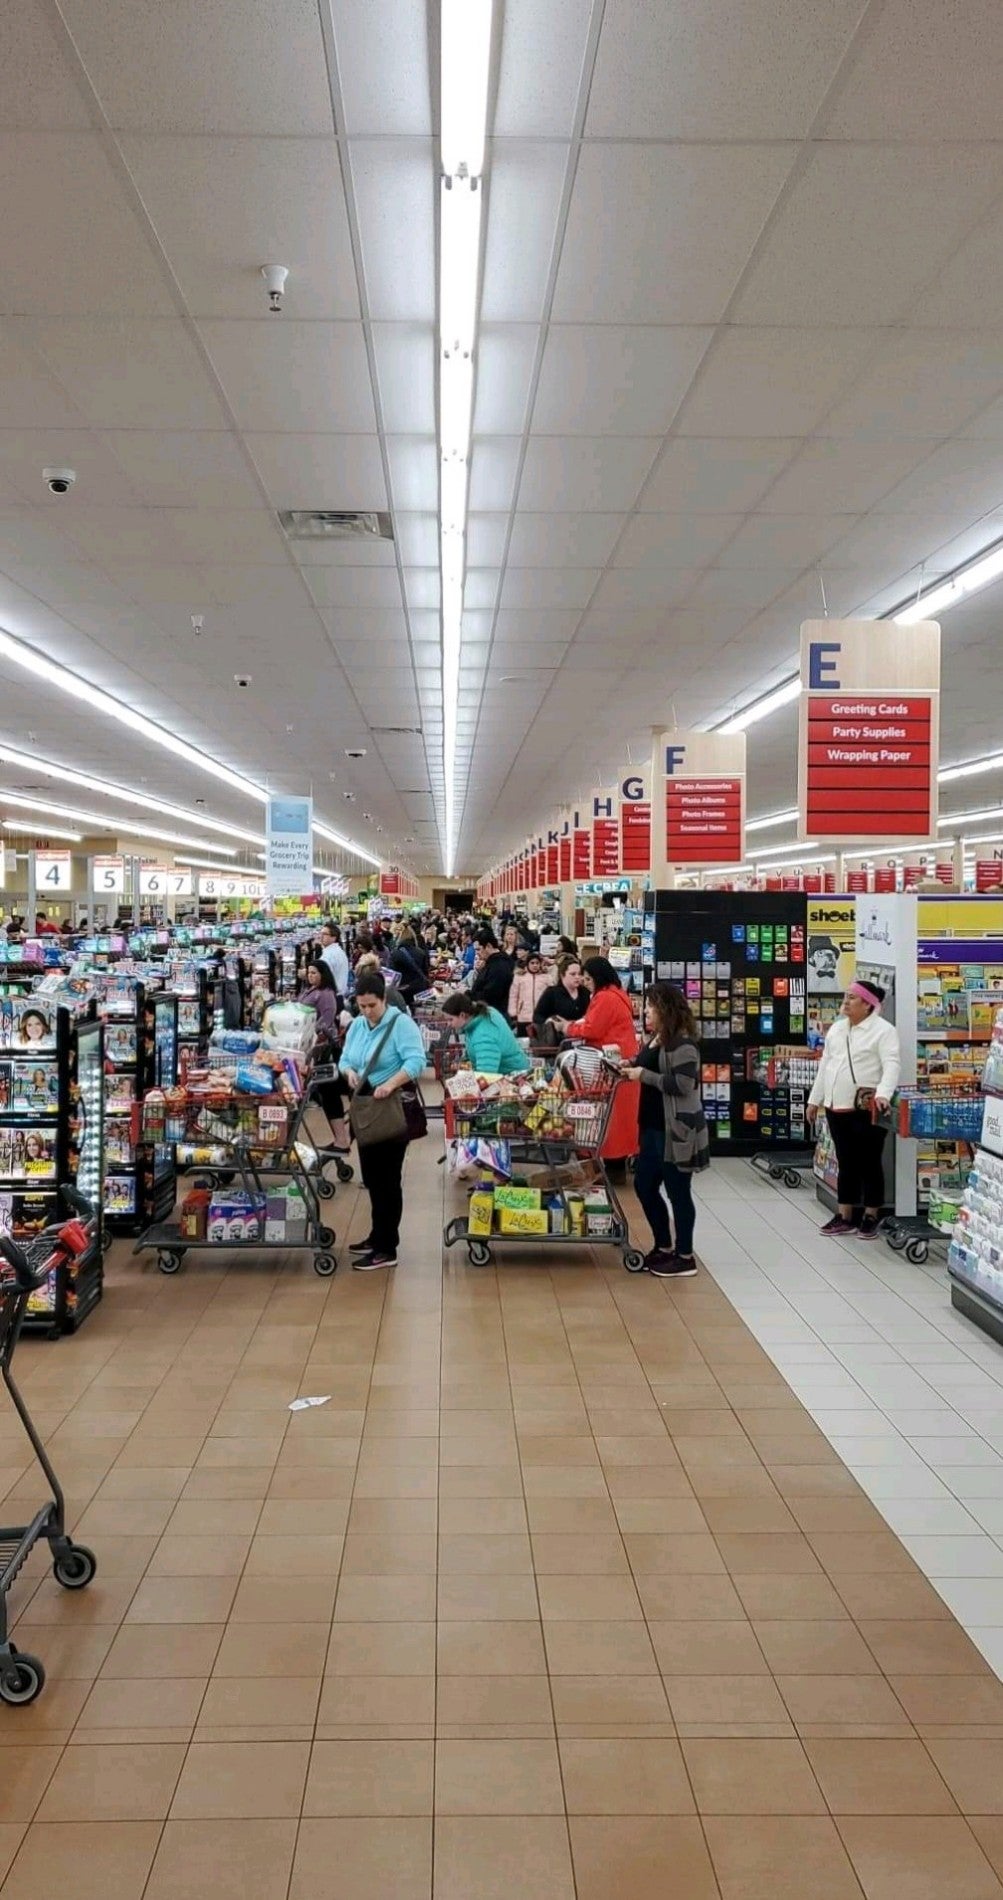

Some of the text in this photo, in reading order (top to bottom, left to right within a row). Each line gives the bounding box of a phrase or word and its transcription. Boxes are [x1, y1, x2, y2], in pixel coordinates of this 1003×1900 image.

[809, 643, 841, 689] E
[831, 703, 908, 716] Greeting Cards
[832, 726, 906, 739] Party Supplies
[666, 747, 685, 774] F
[827, 749, 911, 762] Wrapping Paper
[622, 776, 644, 800] G
[594, 797, 612, 816] H
[560, 821, 569, 836] J
[538, 837, 546, 850] L
[547, 831, 558, 844] K
[271, 840, 309, 850] Make Every
[270, 851, 310, 860] Grocery Trip
[920, 857, 927, 865] P
[994, 850, 1003, 859] N
[272, 861, 307, 871] Rewarding
[861, 863, 868, 871] R
[45, 864, 60, 885] 4
[104, 870, 116, 889] 5
[148, 875, 159, 891] 6
[174, 877, 185, 892] 7
[205, 880, 215, 893] 8
[227, 882, 236, 894] 9
[242, 884, 256, 895] 10
[262, 1110, 268, 1119] B
[570, 1105, 576, 1115] B
